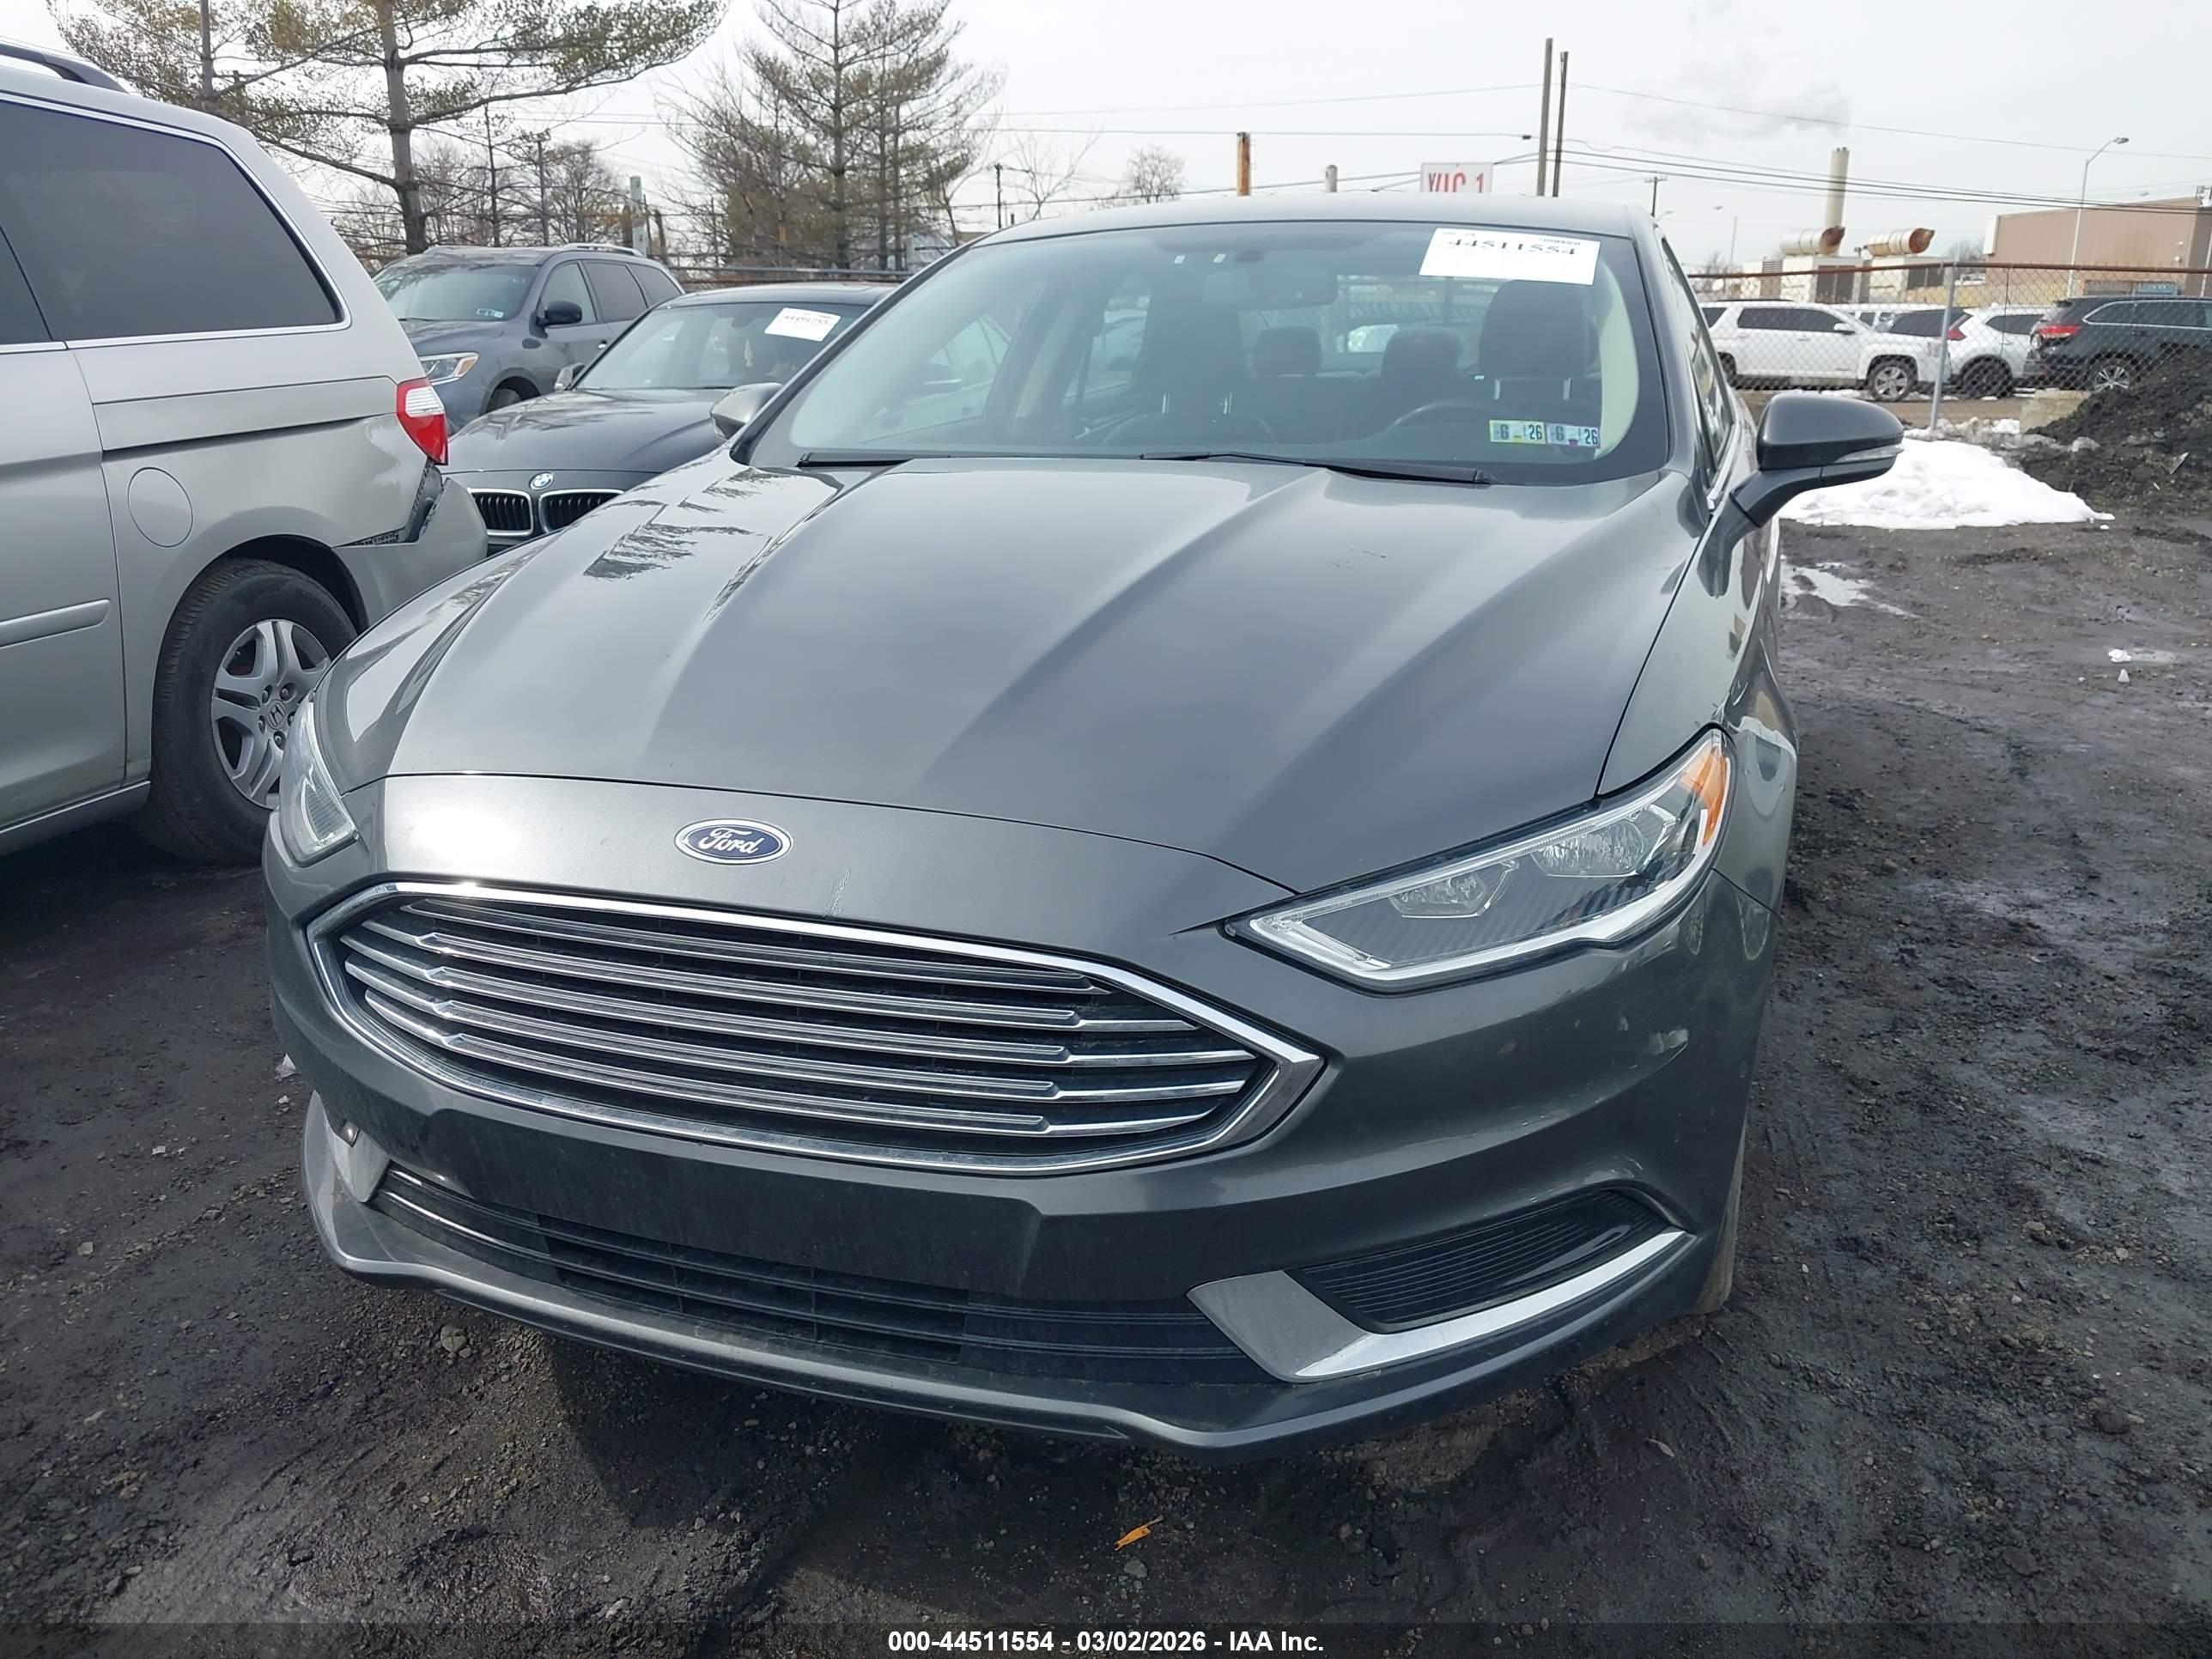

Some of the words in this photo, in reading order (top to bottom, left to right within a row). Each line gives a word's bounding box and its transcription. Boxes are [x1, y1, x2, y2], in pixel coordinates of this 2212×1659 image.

[1447, 239, 1577, 256] 44511554
[1528, 424, 1543, 441] 26
[1584, 428, 1599, 446] 26
[698, 827, 764, 854] Ford
